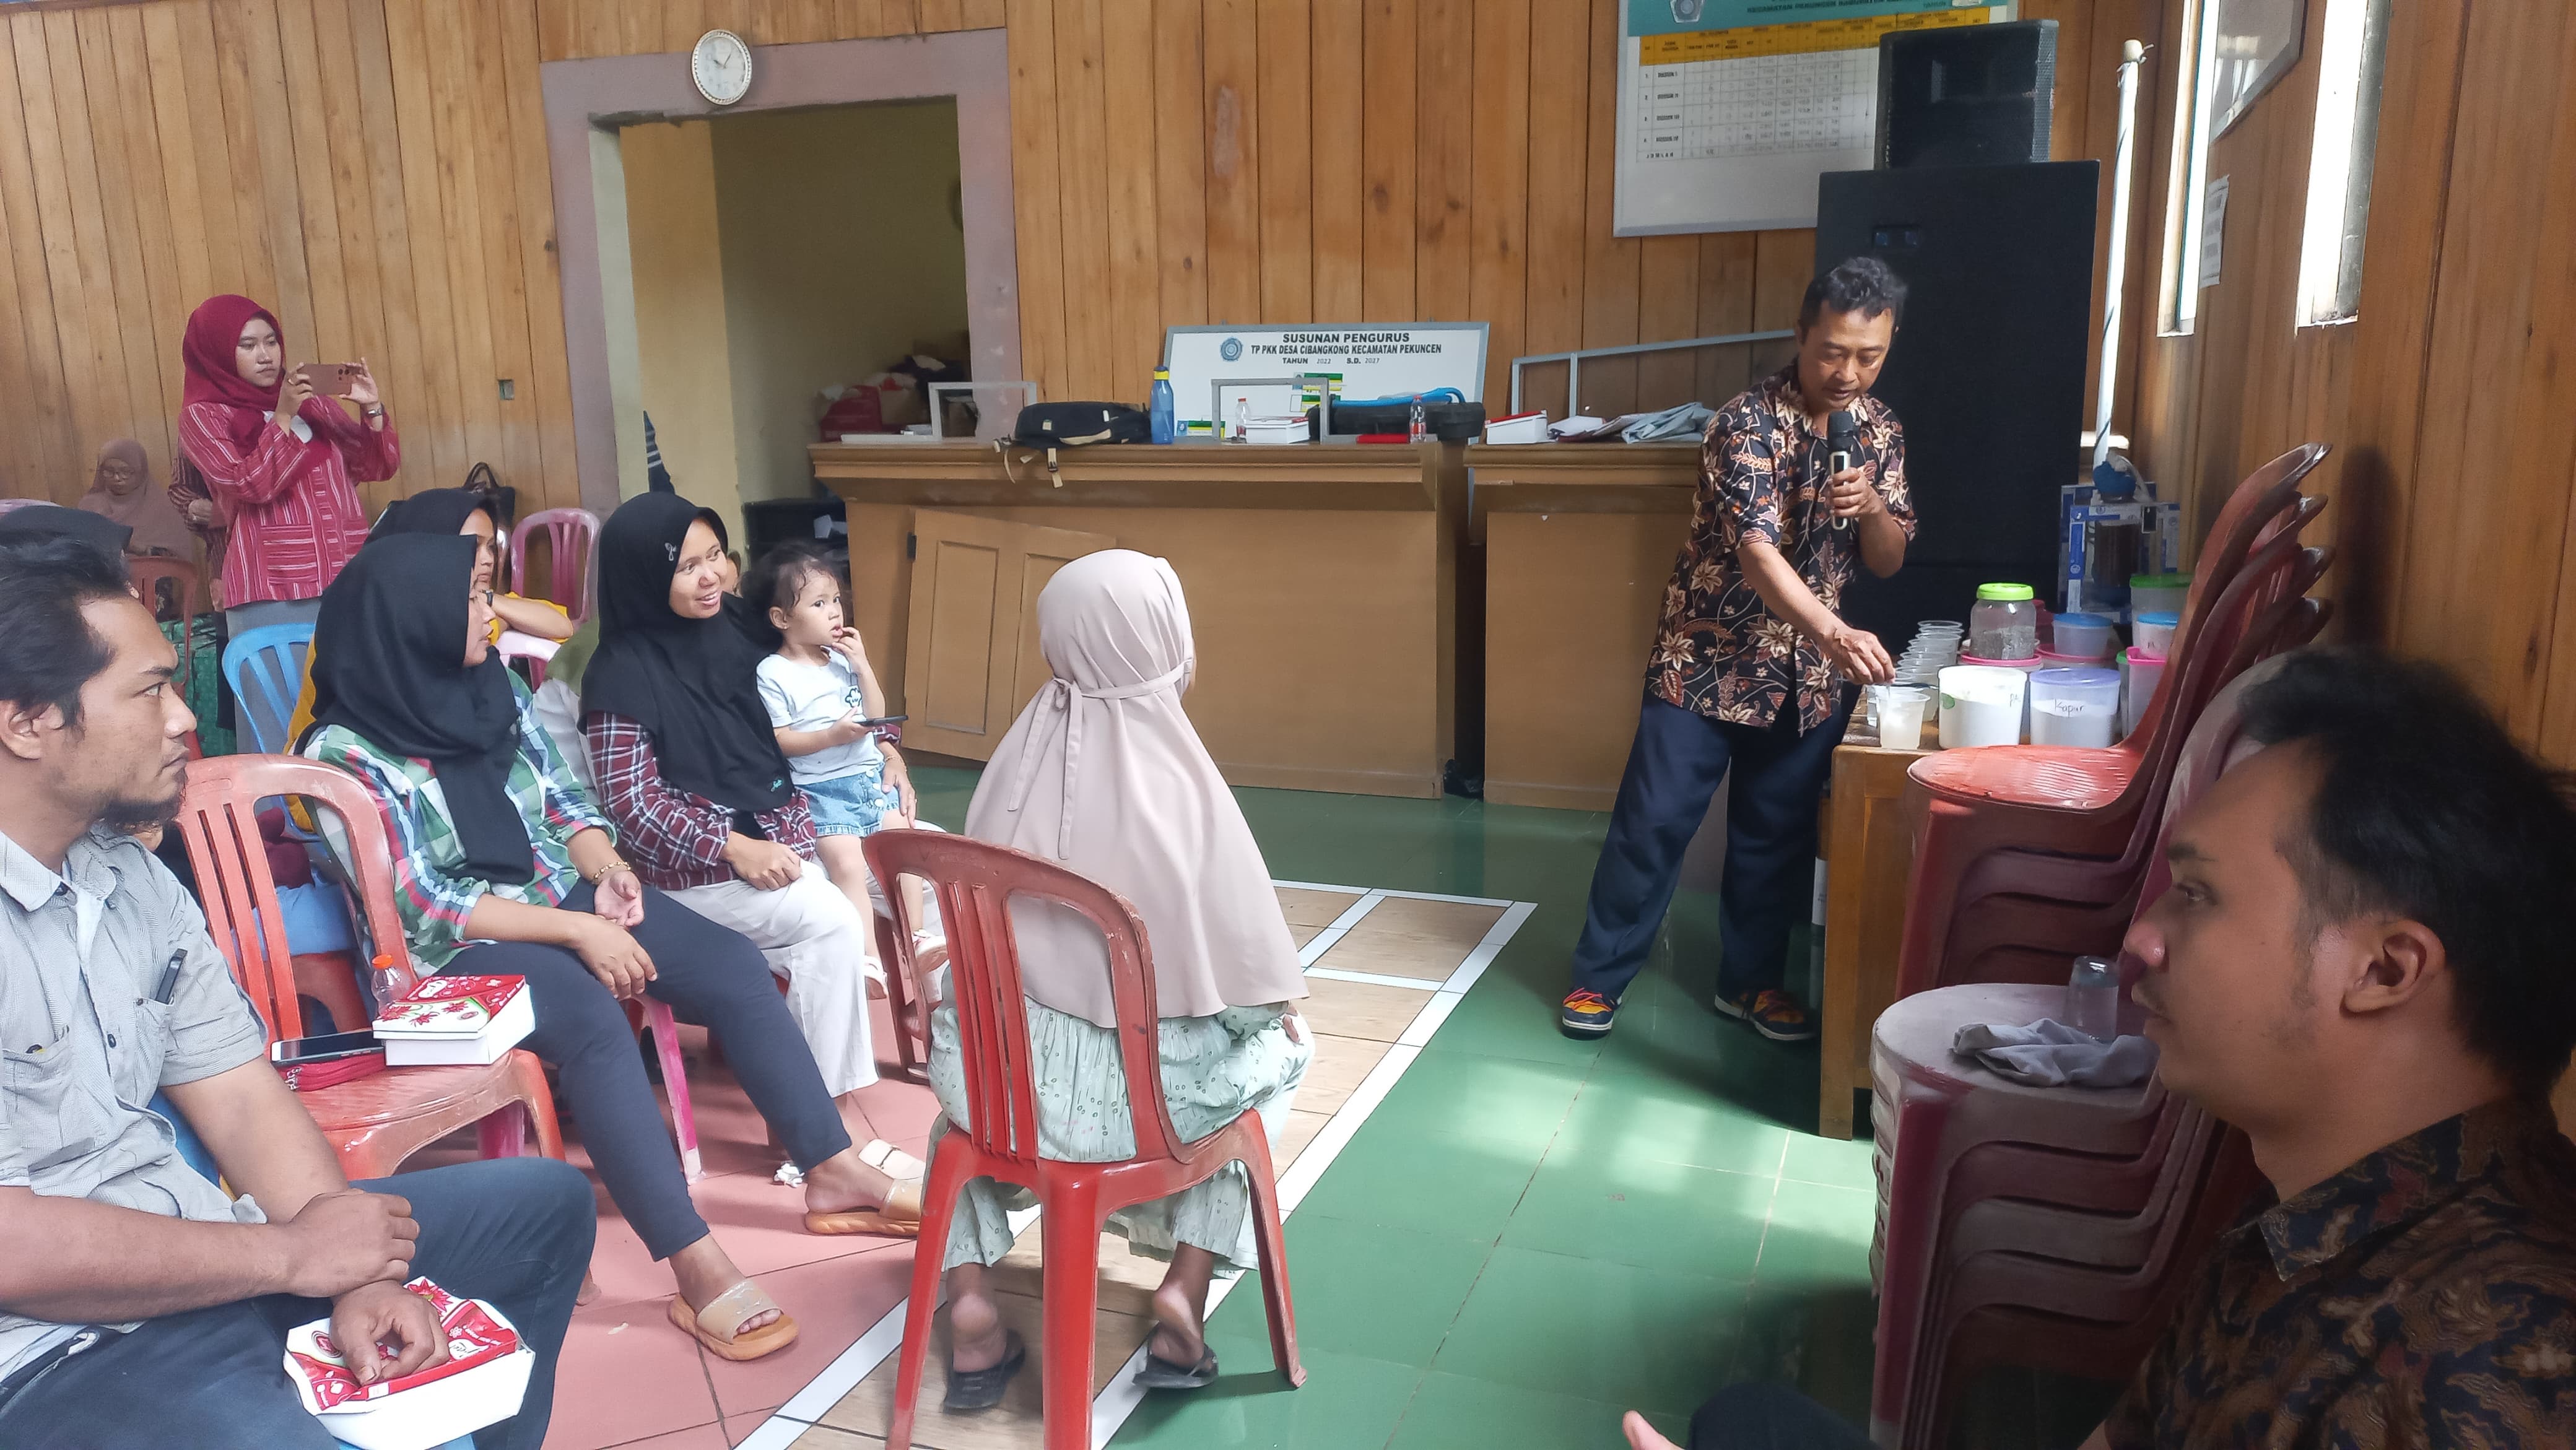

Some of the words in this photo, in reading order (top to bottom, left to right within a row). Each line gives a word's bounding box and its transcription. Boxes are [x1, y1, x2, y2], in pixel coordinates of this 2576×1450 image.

[1282, 333, 1340, 343] SUSUNAN
[1343, 332, 1410, 343] PENGURUS
[1251, 345, 1261, 355] TP
[1261, 344, 1277, 355] PKK
[1279, 344, 1299, 355] DESA
[1300, 344, 1349, 355] CIBANGKONG
[1351, 344, 1398, 355] KECAMATAN
[1399, 344, 1442, 354] PEKUNCEN
[2054, 698, 2085, 718] Kapur
